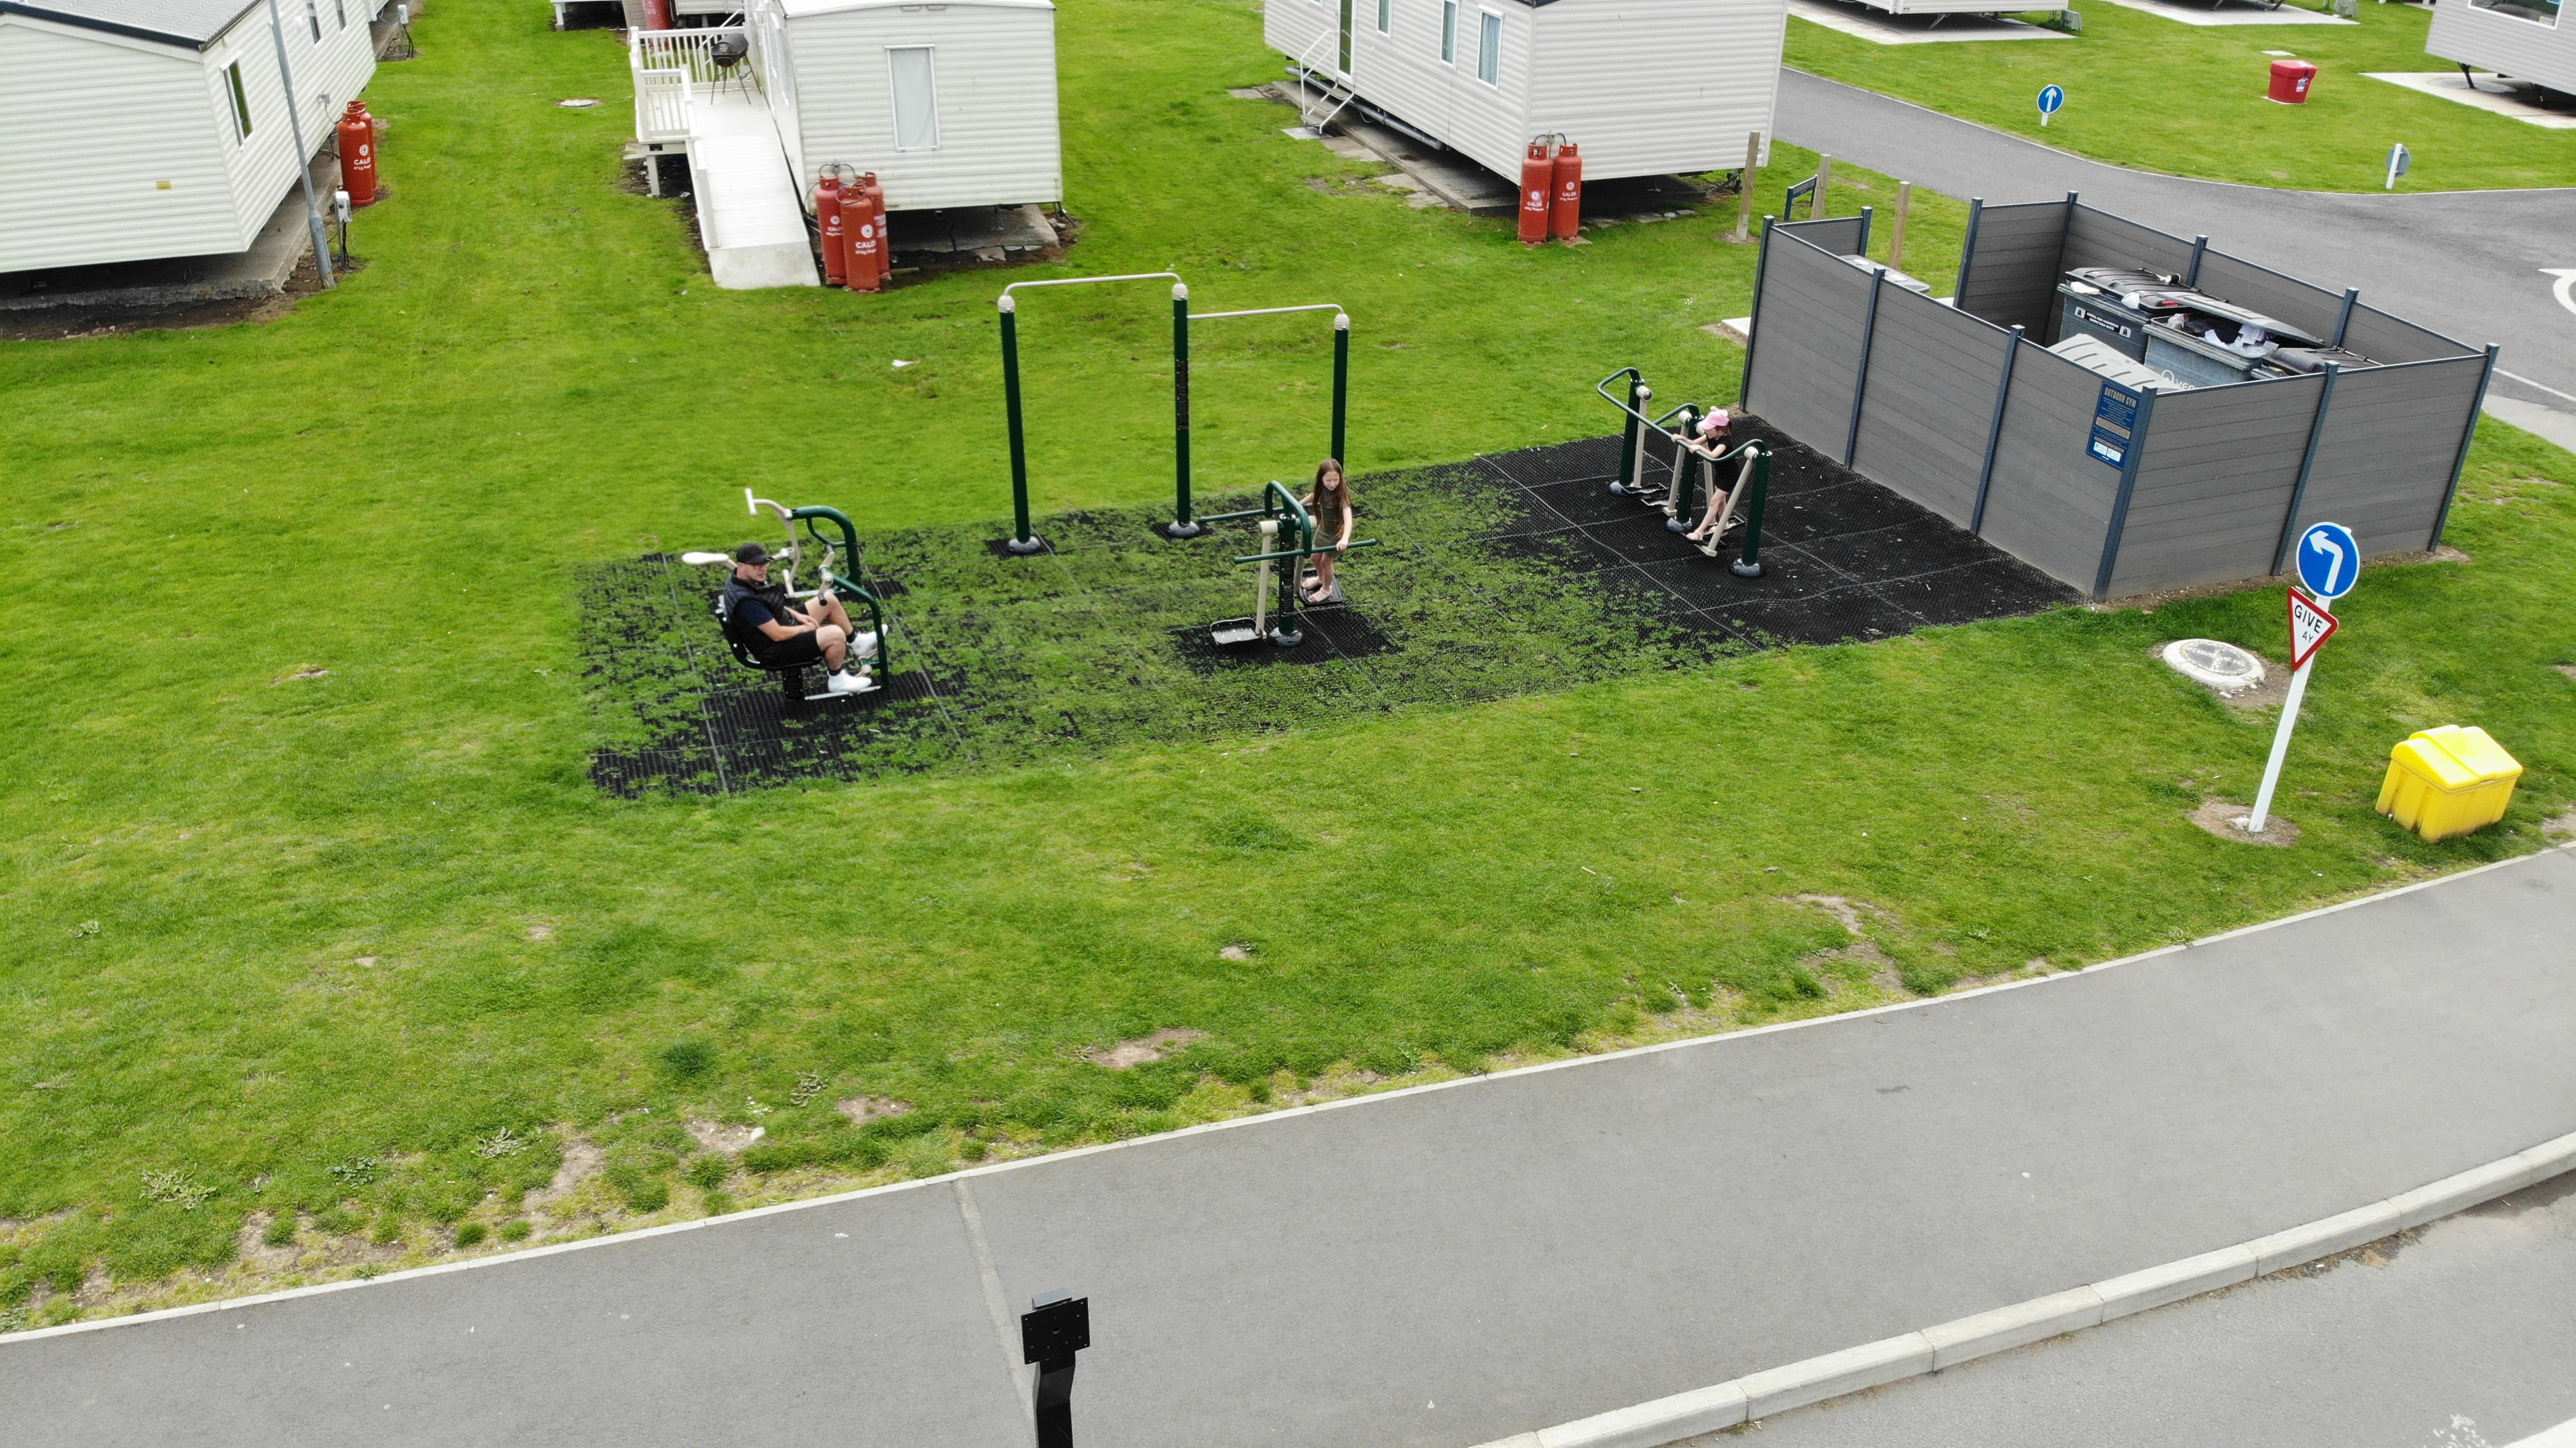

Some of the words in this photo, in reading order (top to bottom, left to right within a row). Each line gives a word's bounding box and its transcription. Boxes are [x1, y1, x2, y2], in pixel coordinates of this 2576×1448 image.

[2104, 387, 2126, 403] OUTDOOR
[2125, 396, 2137, 408] GYM
[2294, 604, 2323, 634] GIVE
